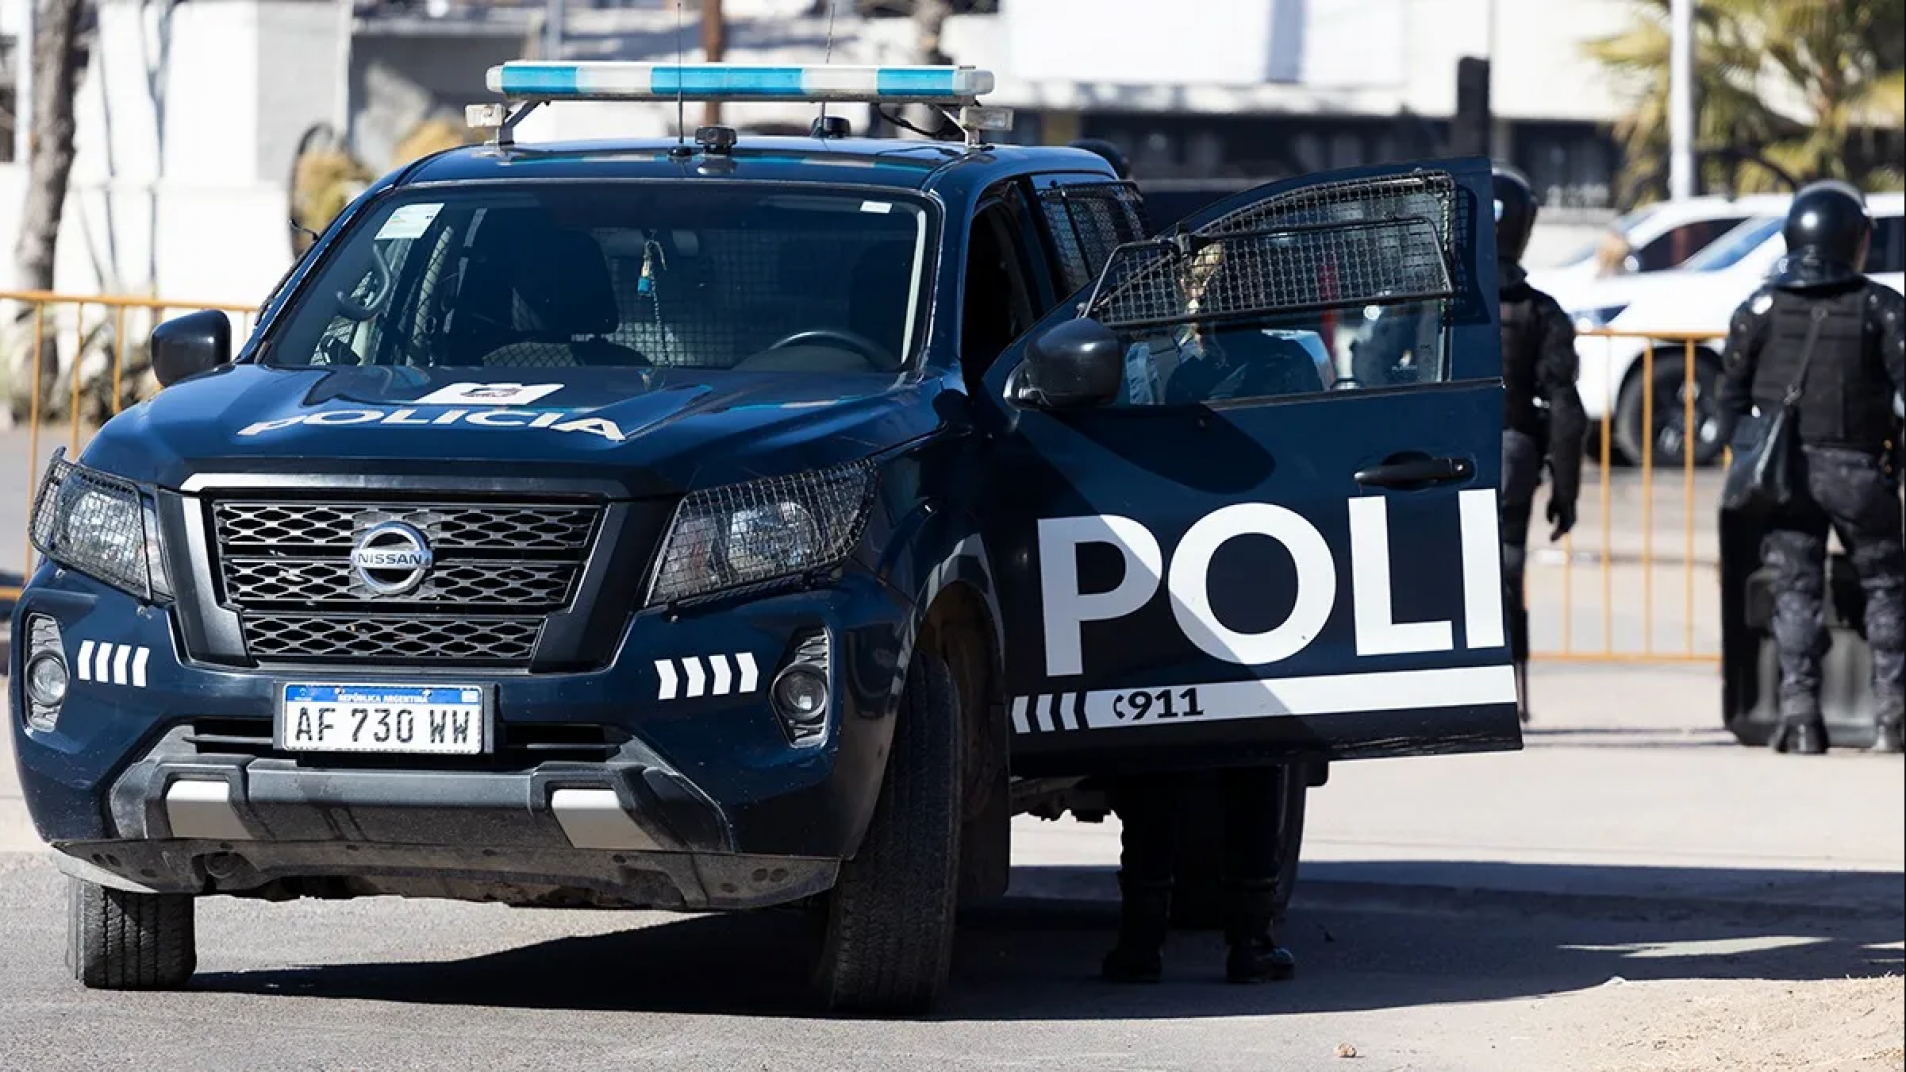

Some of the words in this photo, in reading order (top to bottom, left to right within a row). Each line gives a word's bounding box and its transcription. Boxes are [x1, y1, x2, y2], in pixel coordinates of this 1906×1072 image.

[236, 409, 626, 441] POLICIA
[358, 553, 422, 565] NISSAN
[1037, 488, 1505, 677] POLI
[384, 694, 428, 704] ARGENTINA
[1127, 687, 1204, 720] 911
[295, 707, 335, 742] AF
[351, 708, 414, 743] 730
[429, 709, 470, 743] WW
